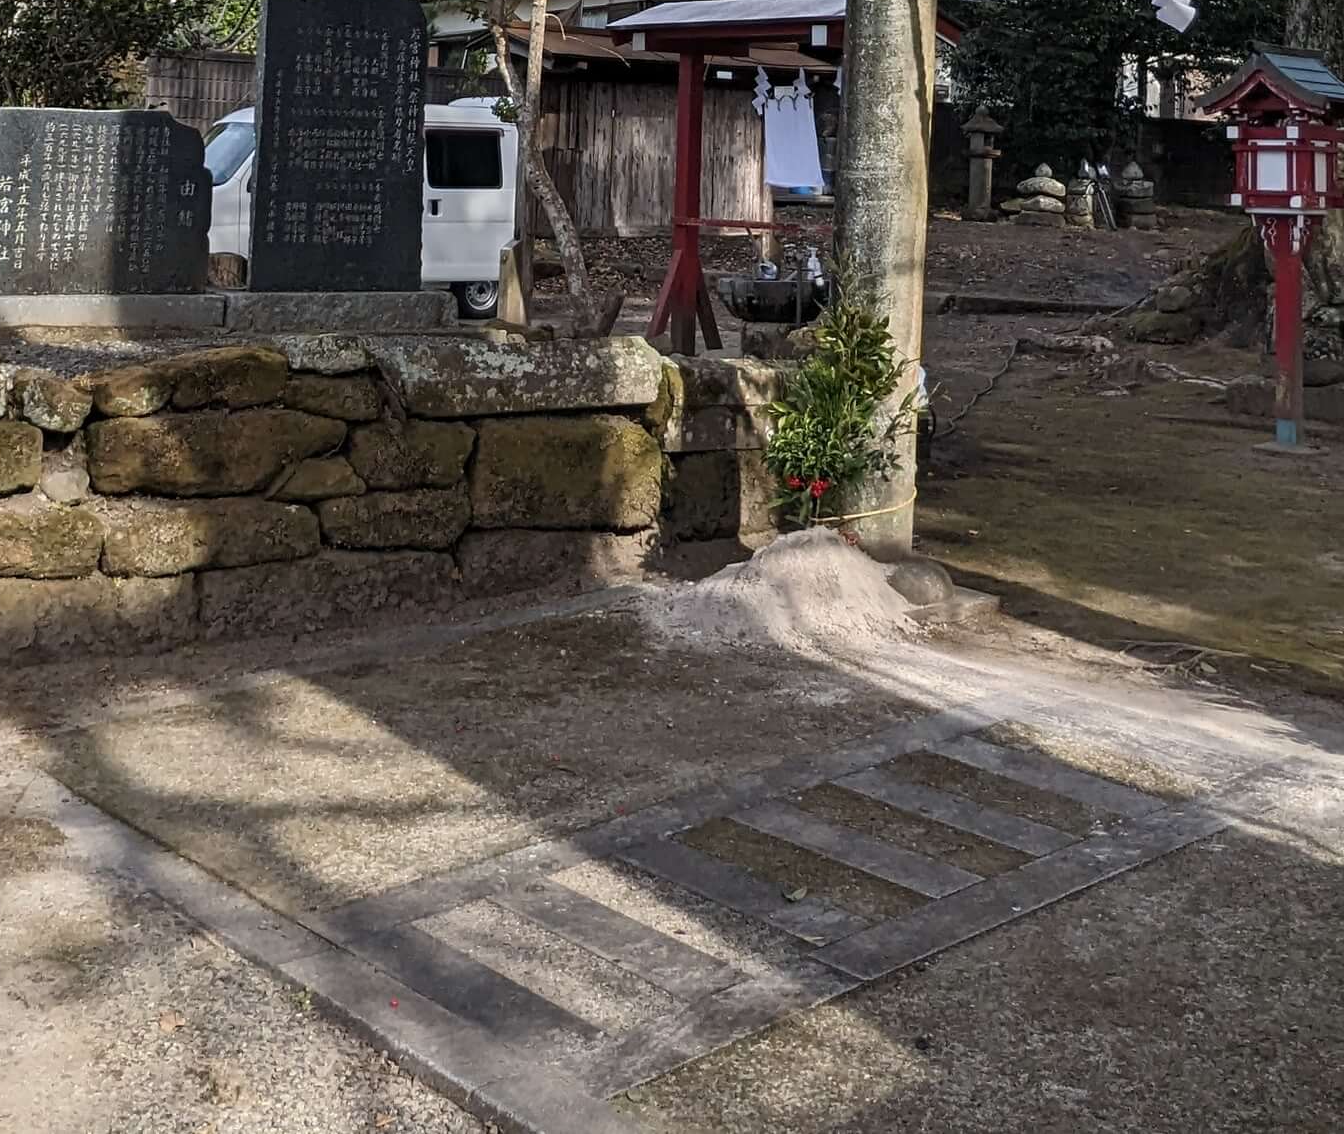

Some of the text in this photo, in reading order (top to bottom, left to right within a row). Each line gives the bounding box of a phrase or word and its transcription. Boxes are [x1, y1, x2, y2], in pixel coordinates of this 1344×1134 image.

[13, 153, 33, 270] 平成十五年五月吉日
[177, 179, 196, 227] 由緒
